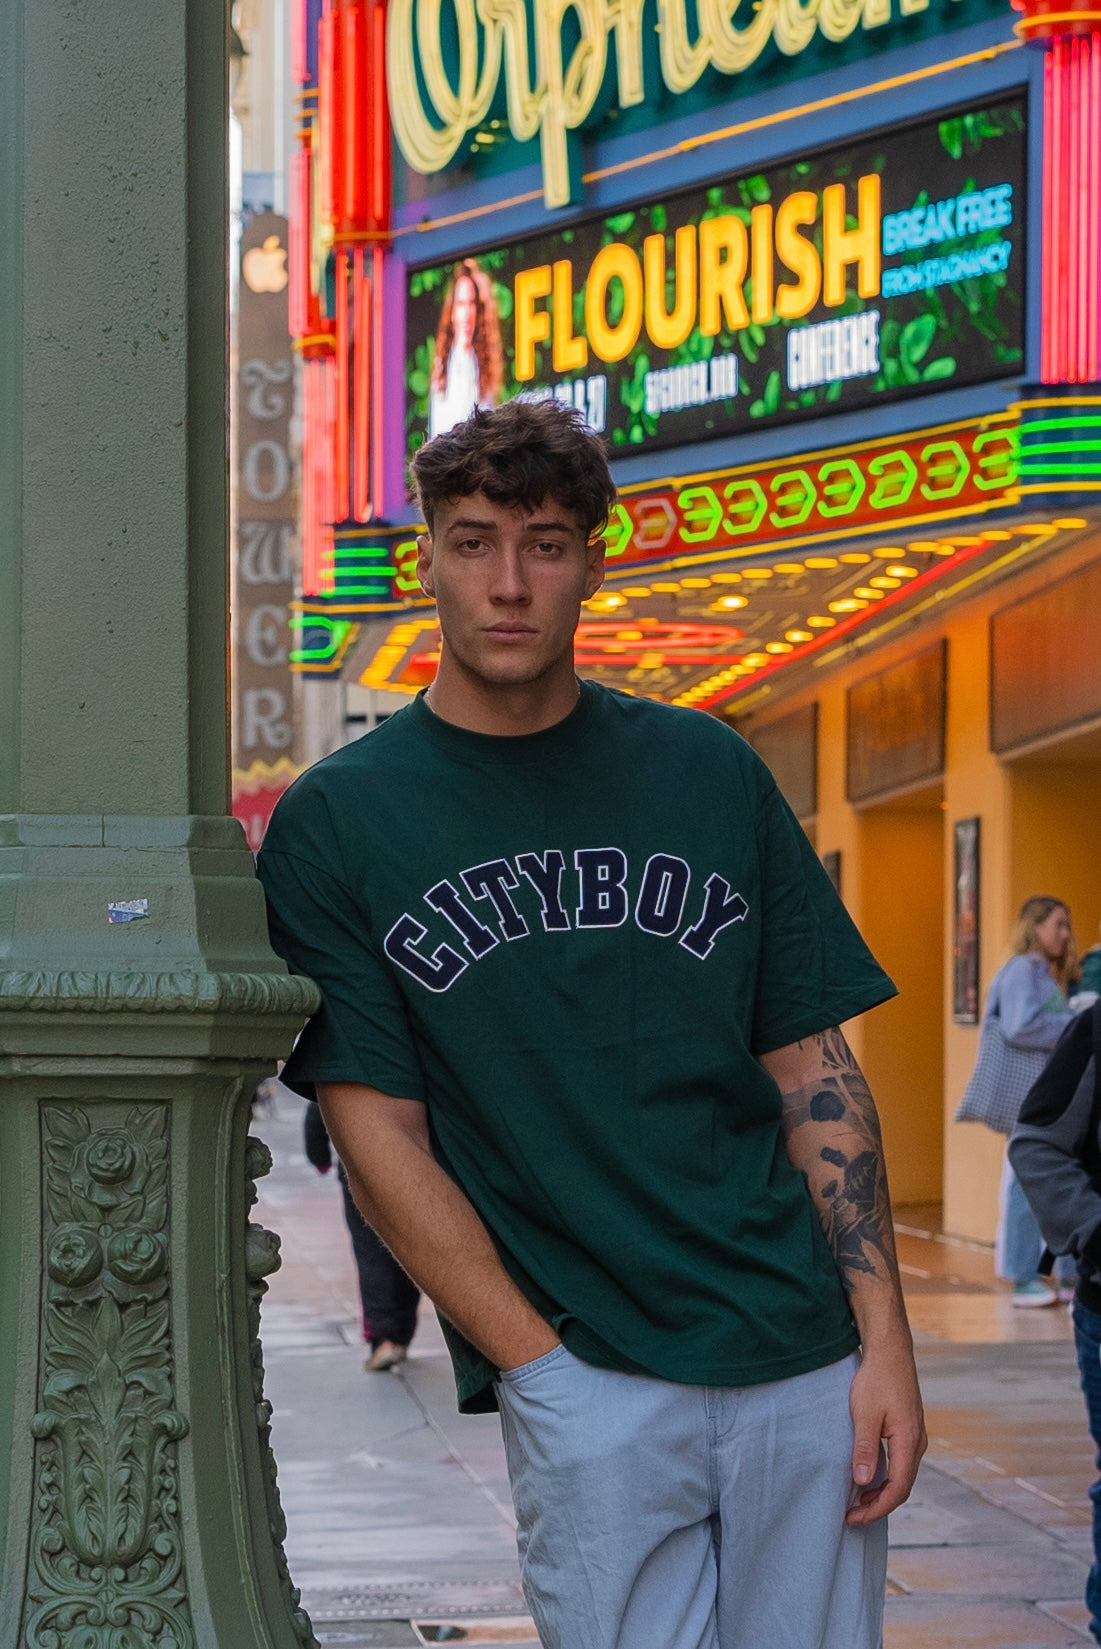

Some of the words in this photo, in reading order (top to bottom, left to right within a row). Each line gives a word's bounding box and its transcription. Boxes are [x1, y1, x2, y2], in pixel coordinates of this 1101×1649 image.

[387, 0, 968, 208] Orpe
[514, 173, 881, 381] FLOURISH
[882, 198, 957, 256] BREAK
[956, 183, 1013, 237] FREE
[383, 847, 749, 993] CITYBOY
